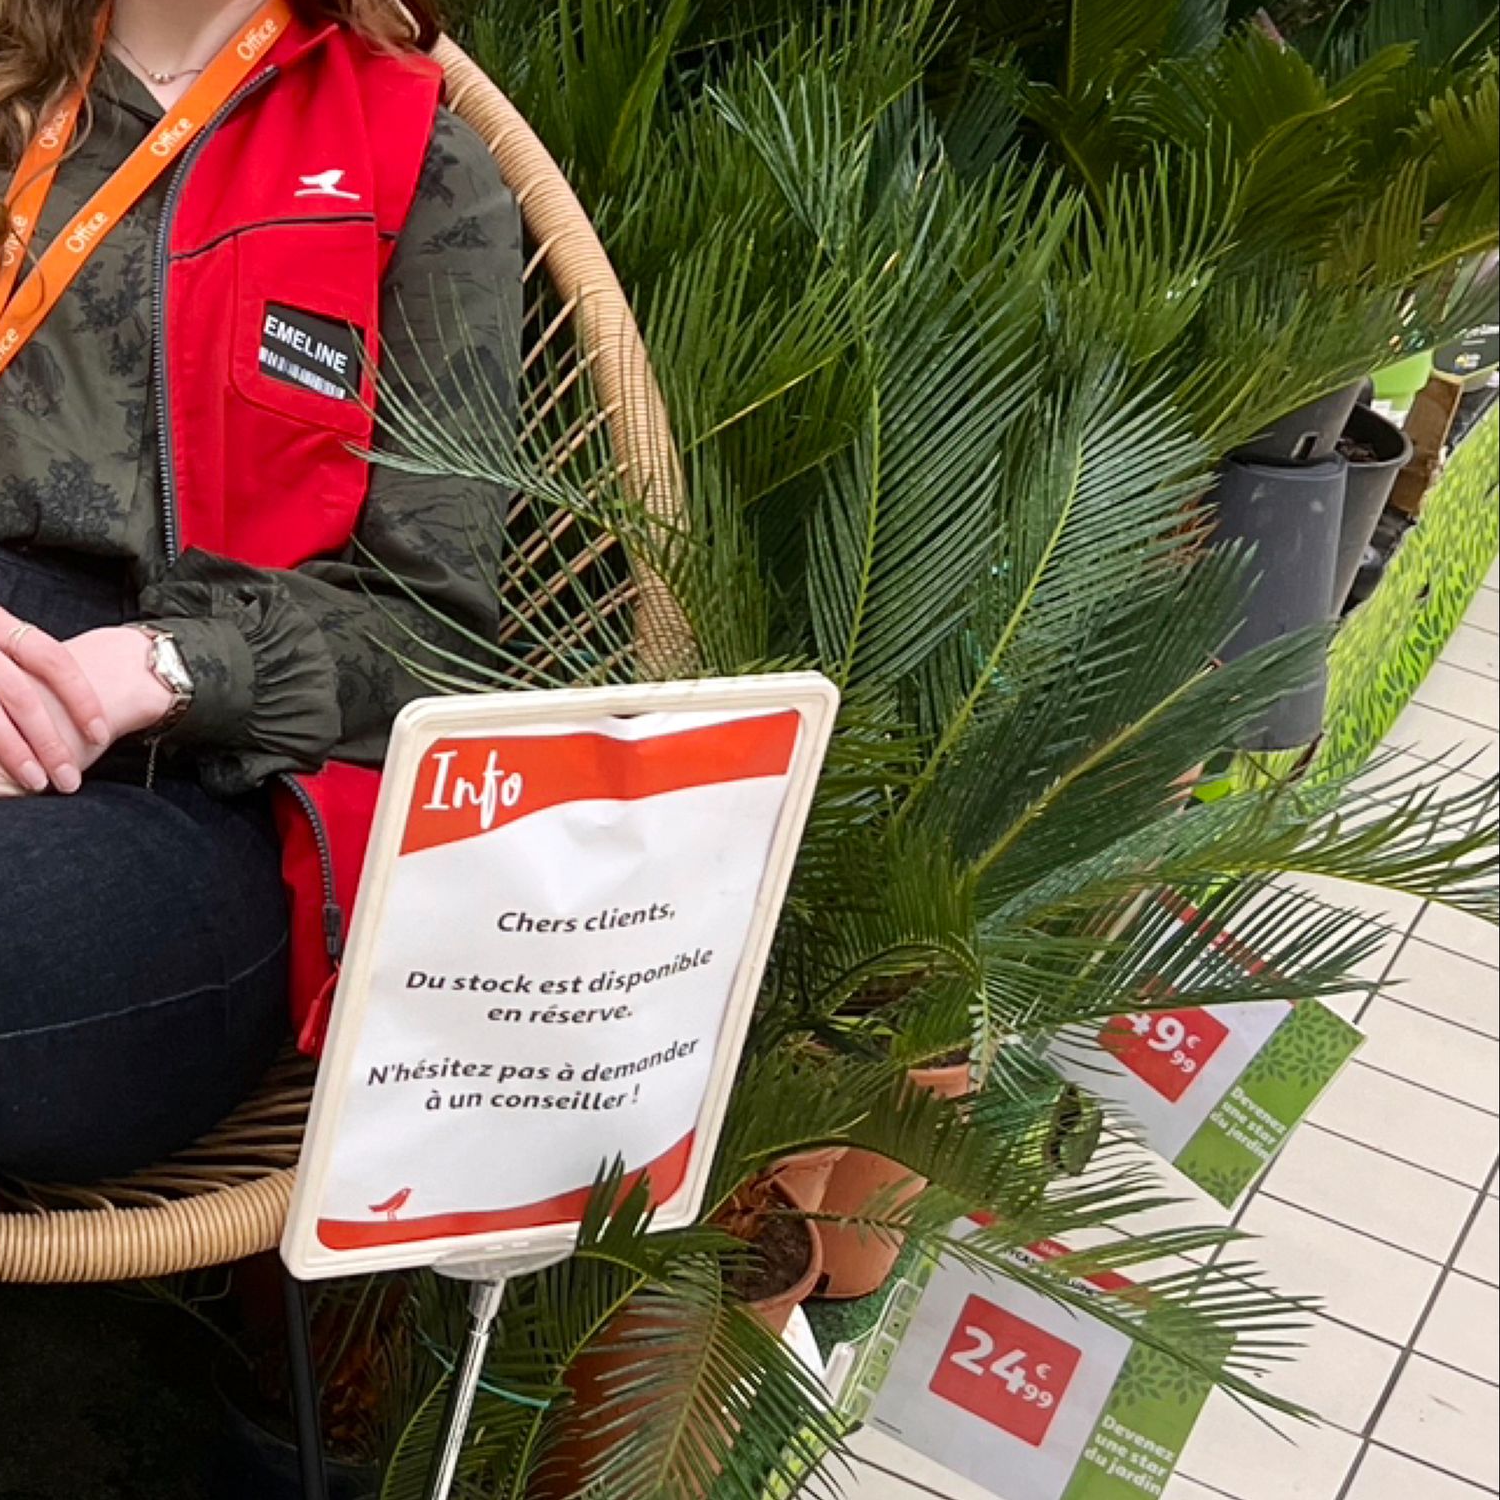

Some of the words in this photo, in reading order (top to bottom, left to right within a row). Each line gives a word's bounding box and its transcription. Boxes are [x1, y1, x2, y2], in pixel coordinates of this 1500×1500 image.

[237, 18, 277, 61] Office
[151, 118, 193, 156] Office
[65, 211, 108, 253] Office
[263, 314, 348, 374] EMELINE
[422, 749, 524, 829] Info
[497, 911, 577, 933] Chers
[584, 901, 676, 931] clients,
[406, 970, 446, 989] Du
[451, 974, 533, 994] stock
[539, 975, 583, 994] est
[588, 948, 713, 993] disponible
[487, 1007, 522, 1023] en
[529, 1003, 633, 1024] réserve.
[366, 1057, 494, 1087] N'hésitez
[498, 1065, 550, 1084] pas
[557, 1062, 575, 1082] à
[581, 1037, 700, 1082] demander
[425, 1089, 441, 1111] à
[449, 1091, 483, 1109] un
[490, 1090, 627, 1111] conseiller
[632, 1083, 640, 1105] !
[1208, 1110, 1227, 1129] du
[1229, 1085, 1287, 1134] Devenez
[1221, 1100, 1248, 1124] une
[1247, 1118, 1277, 1146] star
[1095, 1432, 1127, 1457] une
[1128, 1446, 1169, 1478] star
[1101, 1414, 1174, 1463] Devenez
[1084, 1446, 1106, 1469] du
[1106, 1454, 1163, 1496] jardin
